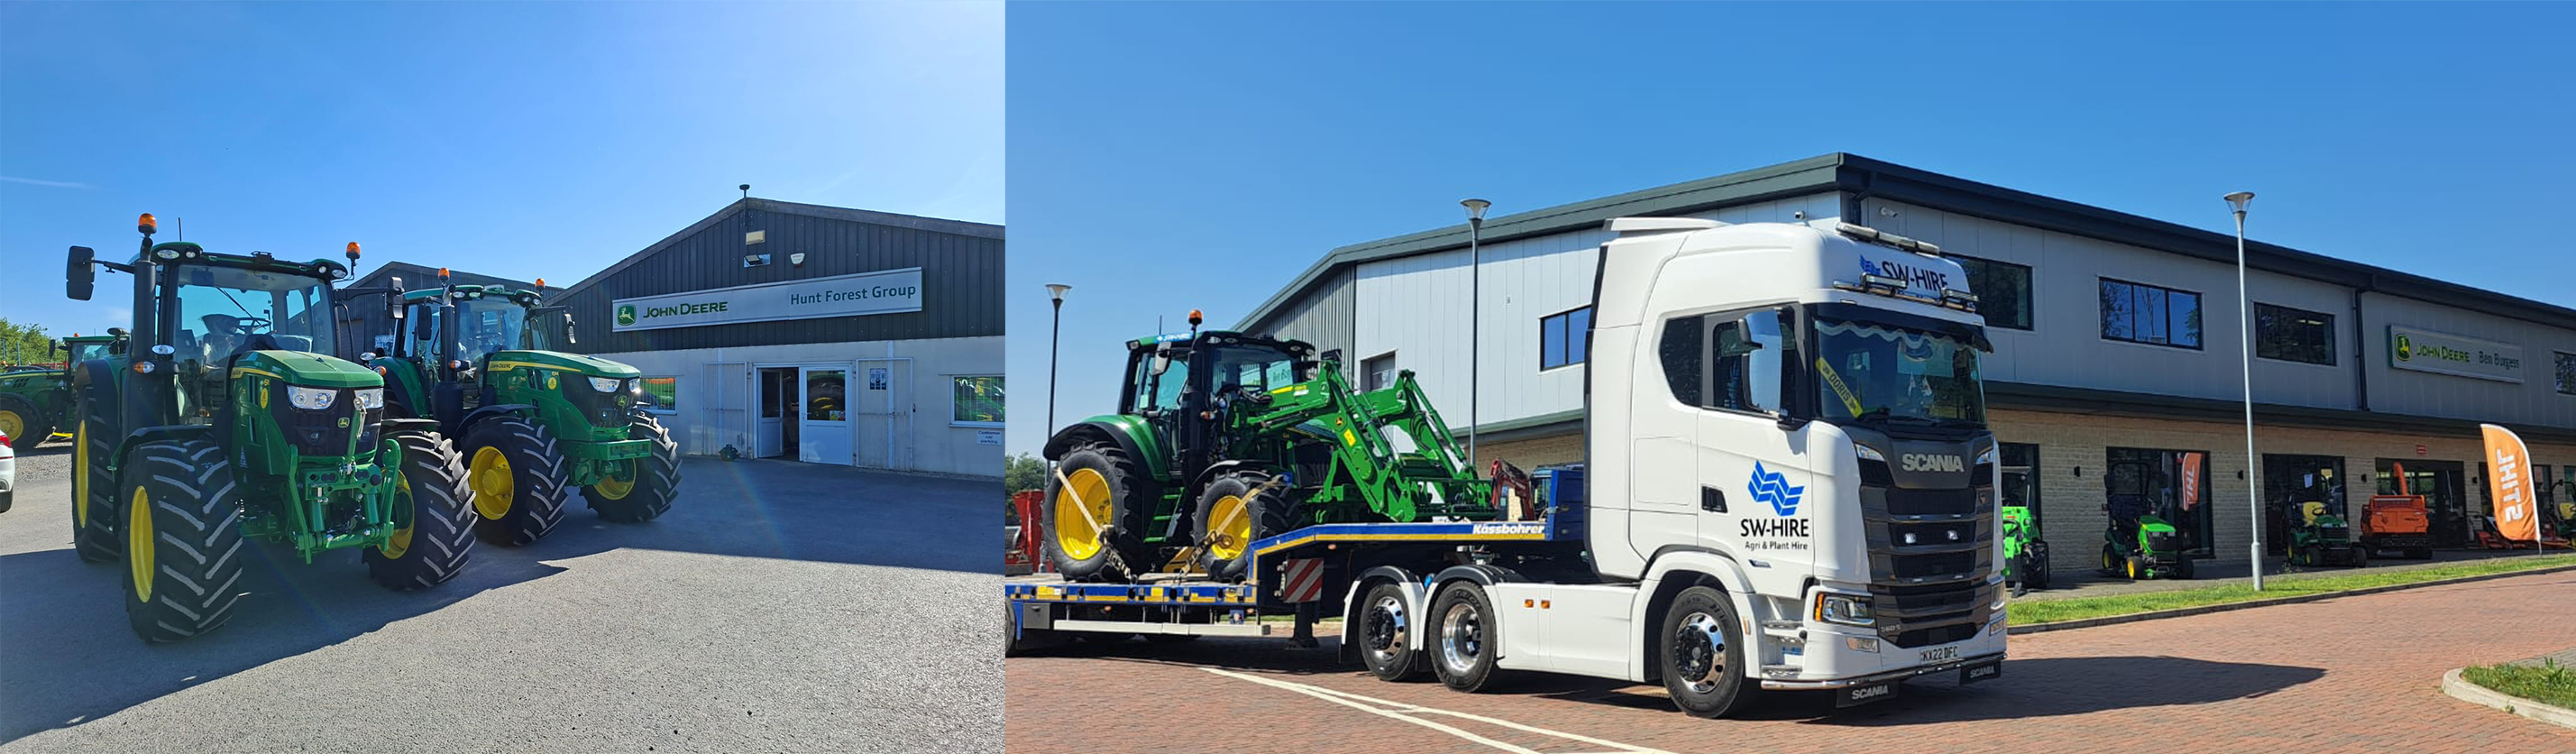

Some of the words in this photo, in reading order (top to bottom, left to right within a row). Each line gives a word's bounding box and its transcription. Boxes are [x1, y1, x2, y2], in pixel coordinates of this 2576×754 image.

[790, 293, 821, 305] Hunt
[825, 288, 867, 302] Forest
[872, 285, 916, 299] Group
[643, 307, 678, 318] JOHN
[680, 301, 728, 316] DEERE
[2417, 343, 2440, 358] JOHN
[2441, 346, 2471, 362] DEERE
[1829, 373, 1851, 401] DORIS
[1902, 453, 1965, 473] SCANIA
[1740, 519, 1809, 537] SW-HIRE
[1745, 541, 1761, 551] Agri
[1762, 541, 1767, 549] &
[1769, 541, 1790, 549] Plant
[1792, 542, 1808, 550] Hire
[1970, 666, 1994, 678] SCANIA
[1852, 685, 1889, 700] SCANIA
